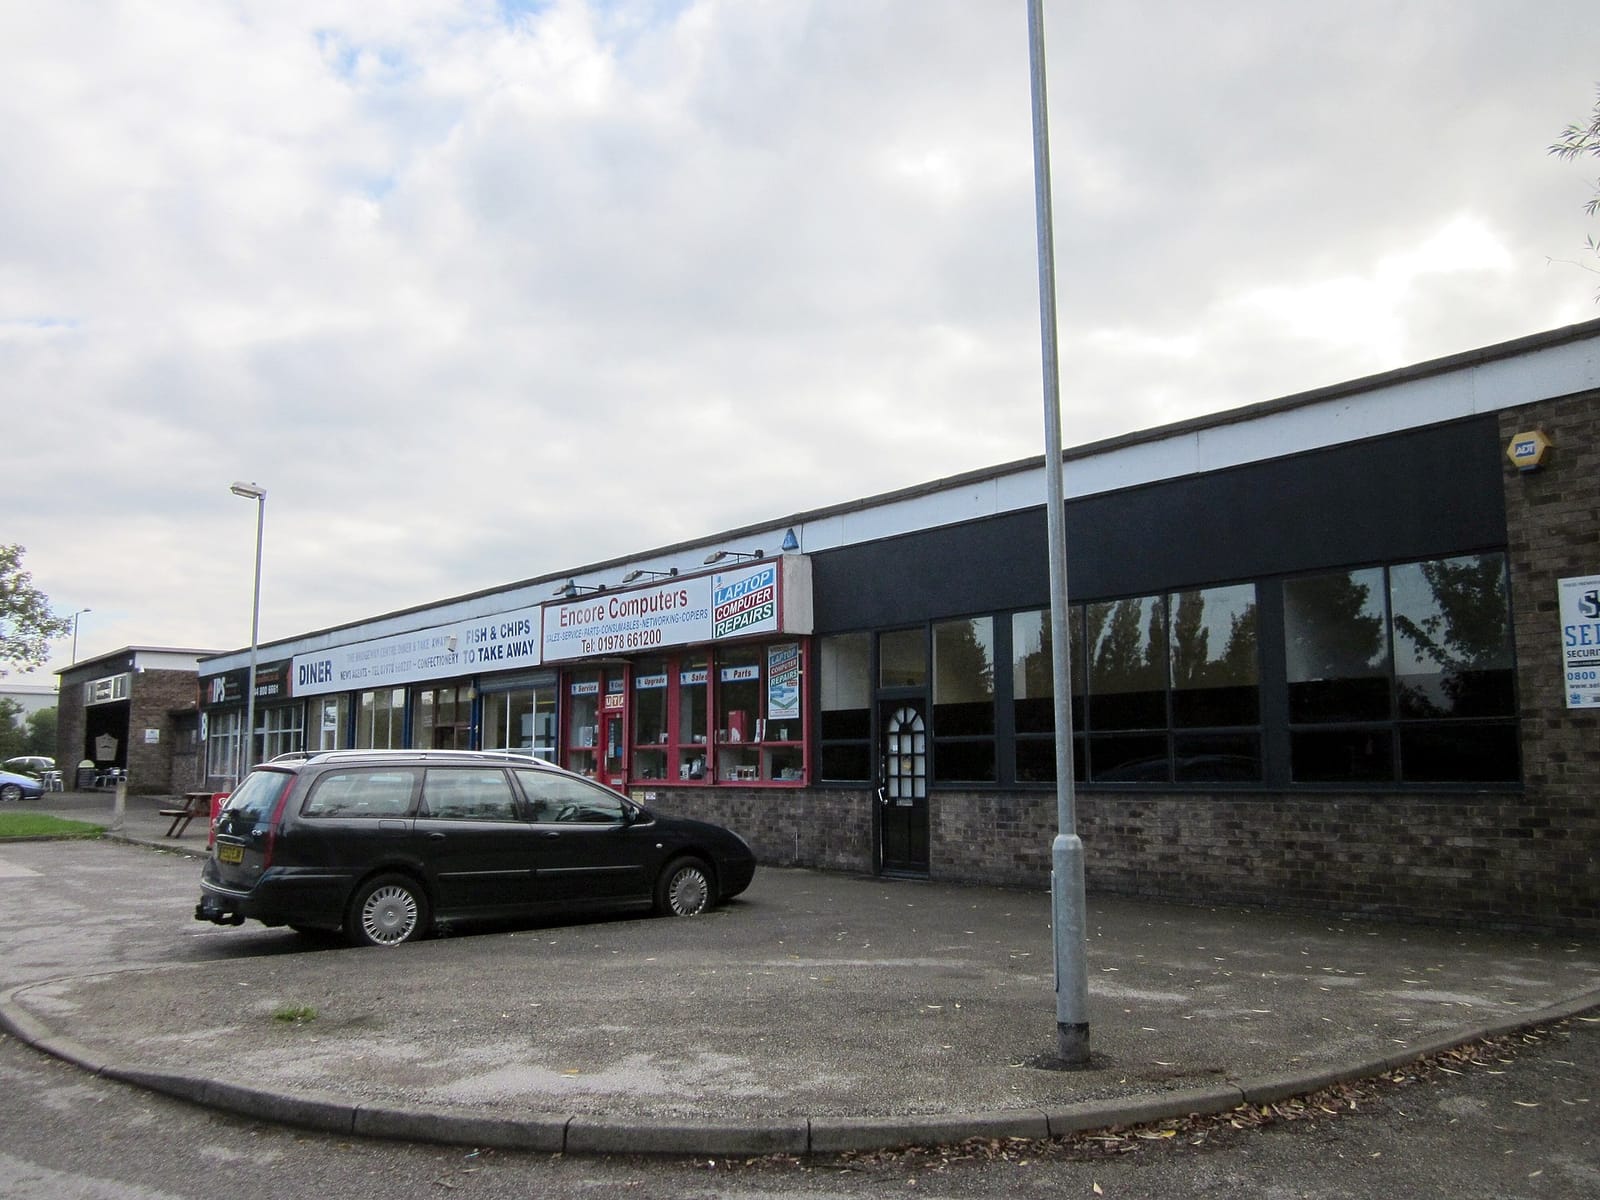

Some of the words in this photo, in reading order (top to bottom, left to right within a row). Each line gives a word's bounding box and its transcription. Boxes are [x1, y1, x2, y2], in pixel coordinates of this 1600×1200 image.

[1516, 443, 1536, 455] ADT
[718, 571, 770, 604] LAPTOP
[560, 605, 604, 627] Encore
[609, 590, 688, 619] Computers
[716, 588, 771, 620] COMPUTER
[716, 604, 772, 636] REPAIRS
[466, 627, 487, 644] FISH
[490, 626, 497, 640] &
[500, 619, 531, 638] CHIPS
[598, 634, 624, 651] 01978
[627, 629, 661, 648] 661200
[417, 653, 459, 669] CONFECTIONERY
[463, 649, 475, 664] TO
[478, 645, 503, 662] TAKE
[506, 640, 534, 658] AWAY
[1567, 649, 1600, 658] SECURI
[299, 660, 332, 686] DINER
[644, 677, 664, 687] Upgrade
[733, 669, 752, 679] Parts
[771, 670, 797, 687] REPAIRS
[1567, 671, 1596, 681] 0800
[578, 685, 597, 693] Service
